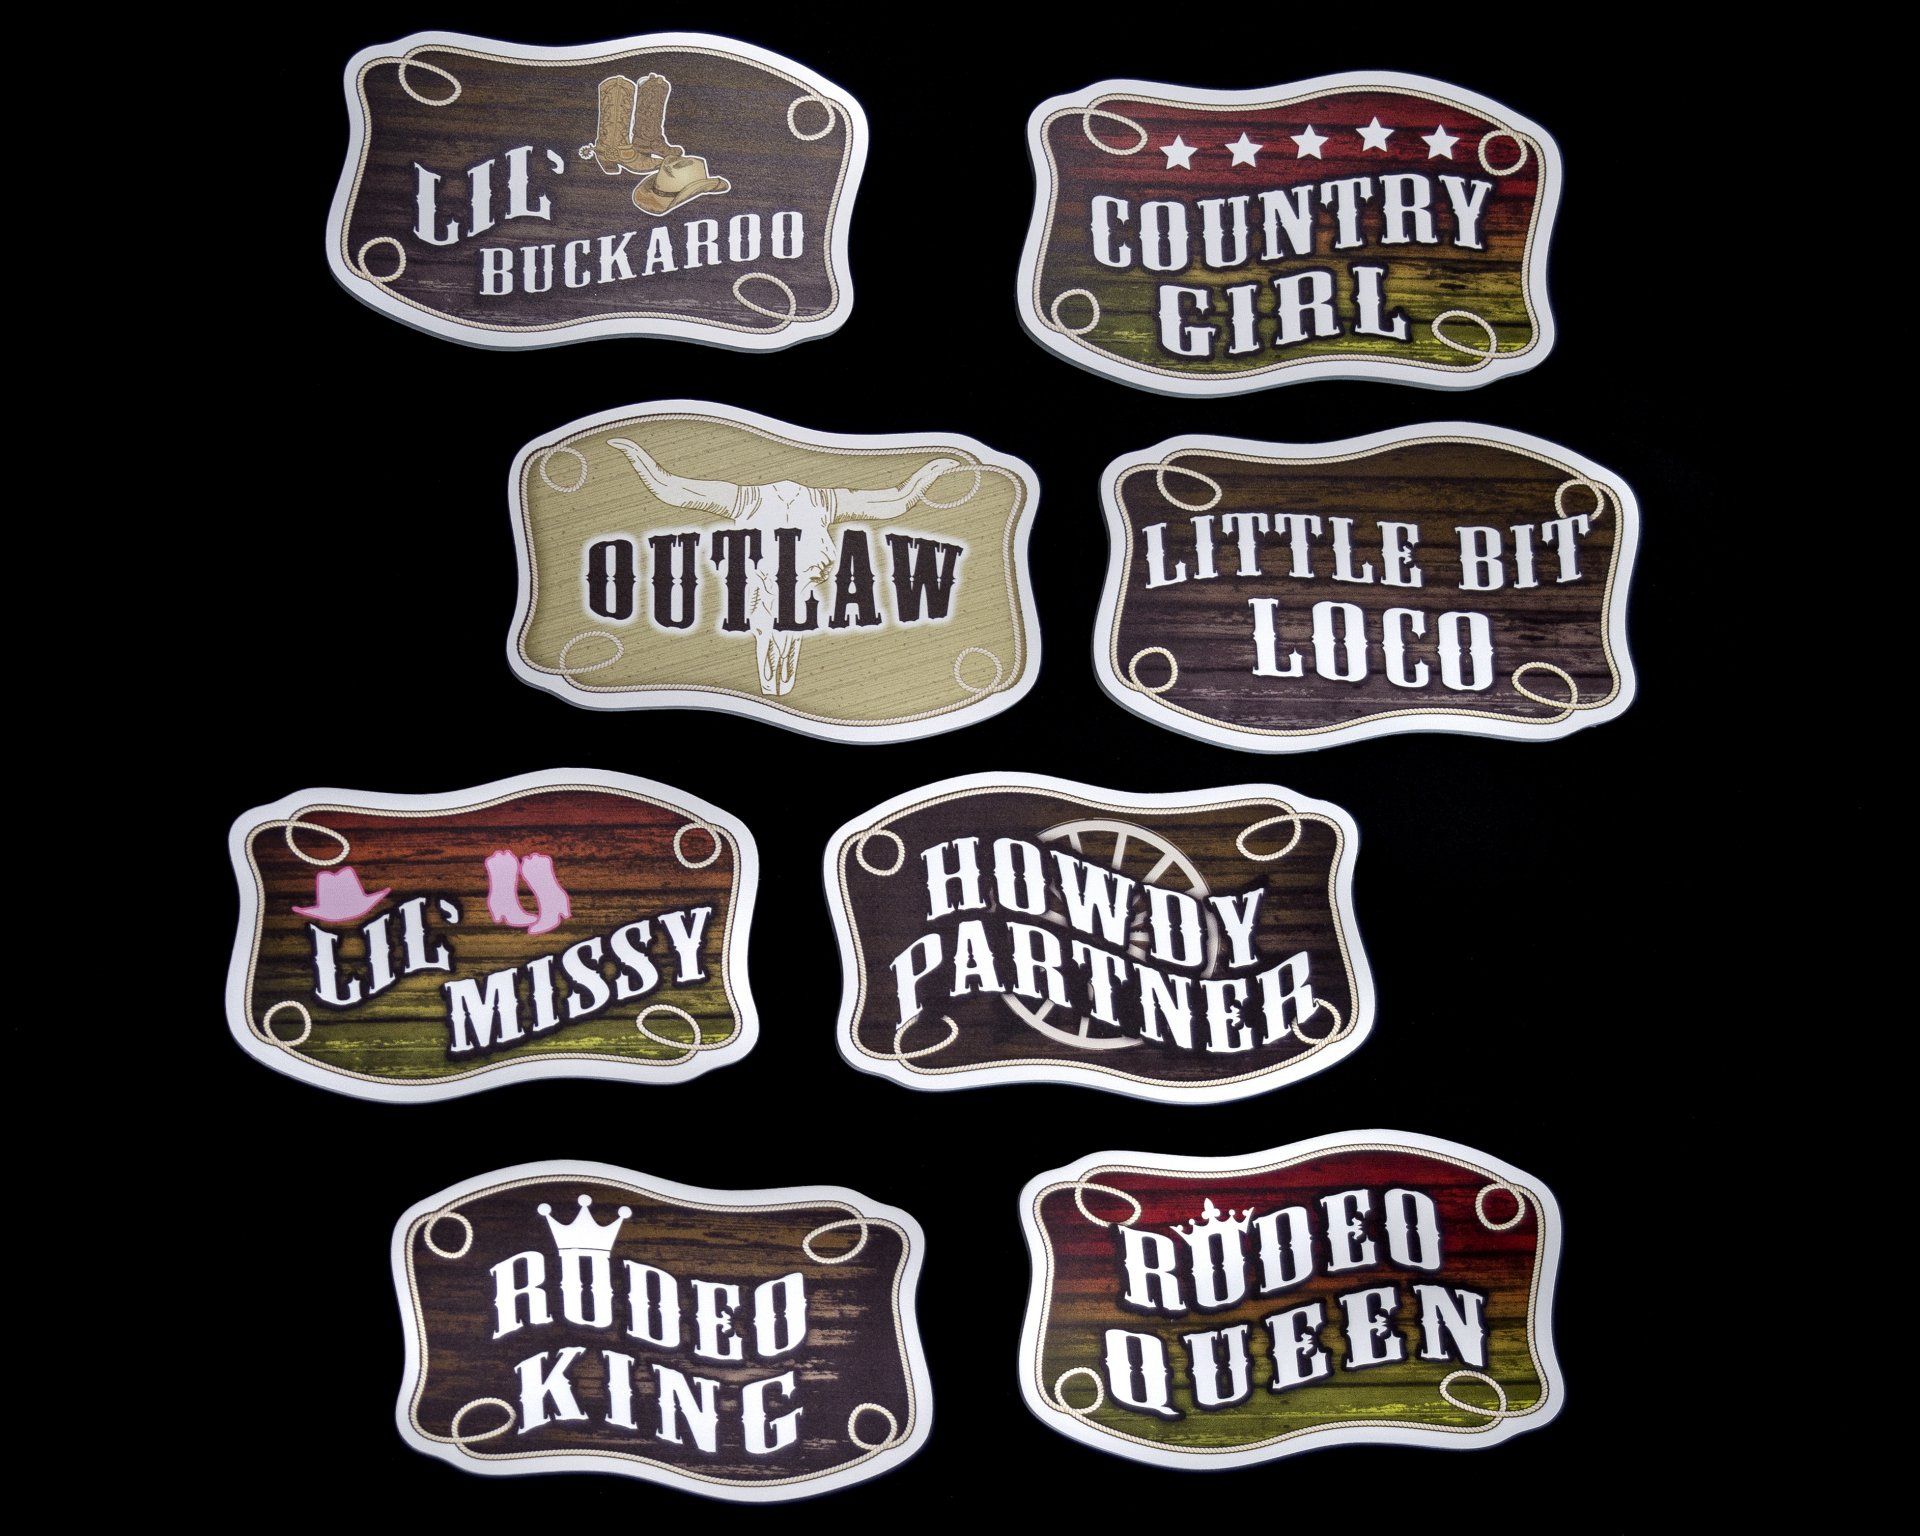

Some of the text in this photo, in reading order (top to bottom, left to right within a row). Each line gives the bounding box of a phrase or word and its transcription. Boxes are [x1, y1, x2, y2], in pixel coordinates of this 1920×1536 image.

[413, 145, 564, 246] LIL'
[1090, 173, 1493, 271] COUNTRY
[479, 211, 805, 296] BUCKAROO
[1158, 265, 1411, 357] GIRL
[585, 527, 964, 632] OUTLAW
[1142, 512, 1592, 591] LITTLE BIT
[1247, 597, 1494, 691] LOCO
[309, 897, 459, 1006] LIL'
[920, 836, 1265, 968] HOWDY
[443, 906, 712, 1052] MISSY
[889, 919, 1319, 1053] PARTNER
[1118, 1188, 1443, 1311] RODEO
[489, 1248, 807, 1361] RODEO
[1104, 1284, 1485, 1416] QUEEN
[513, 1346, 804, 1455] KING
